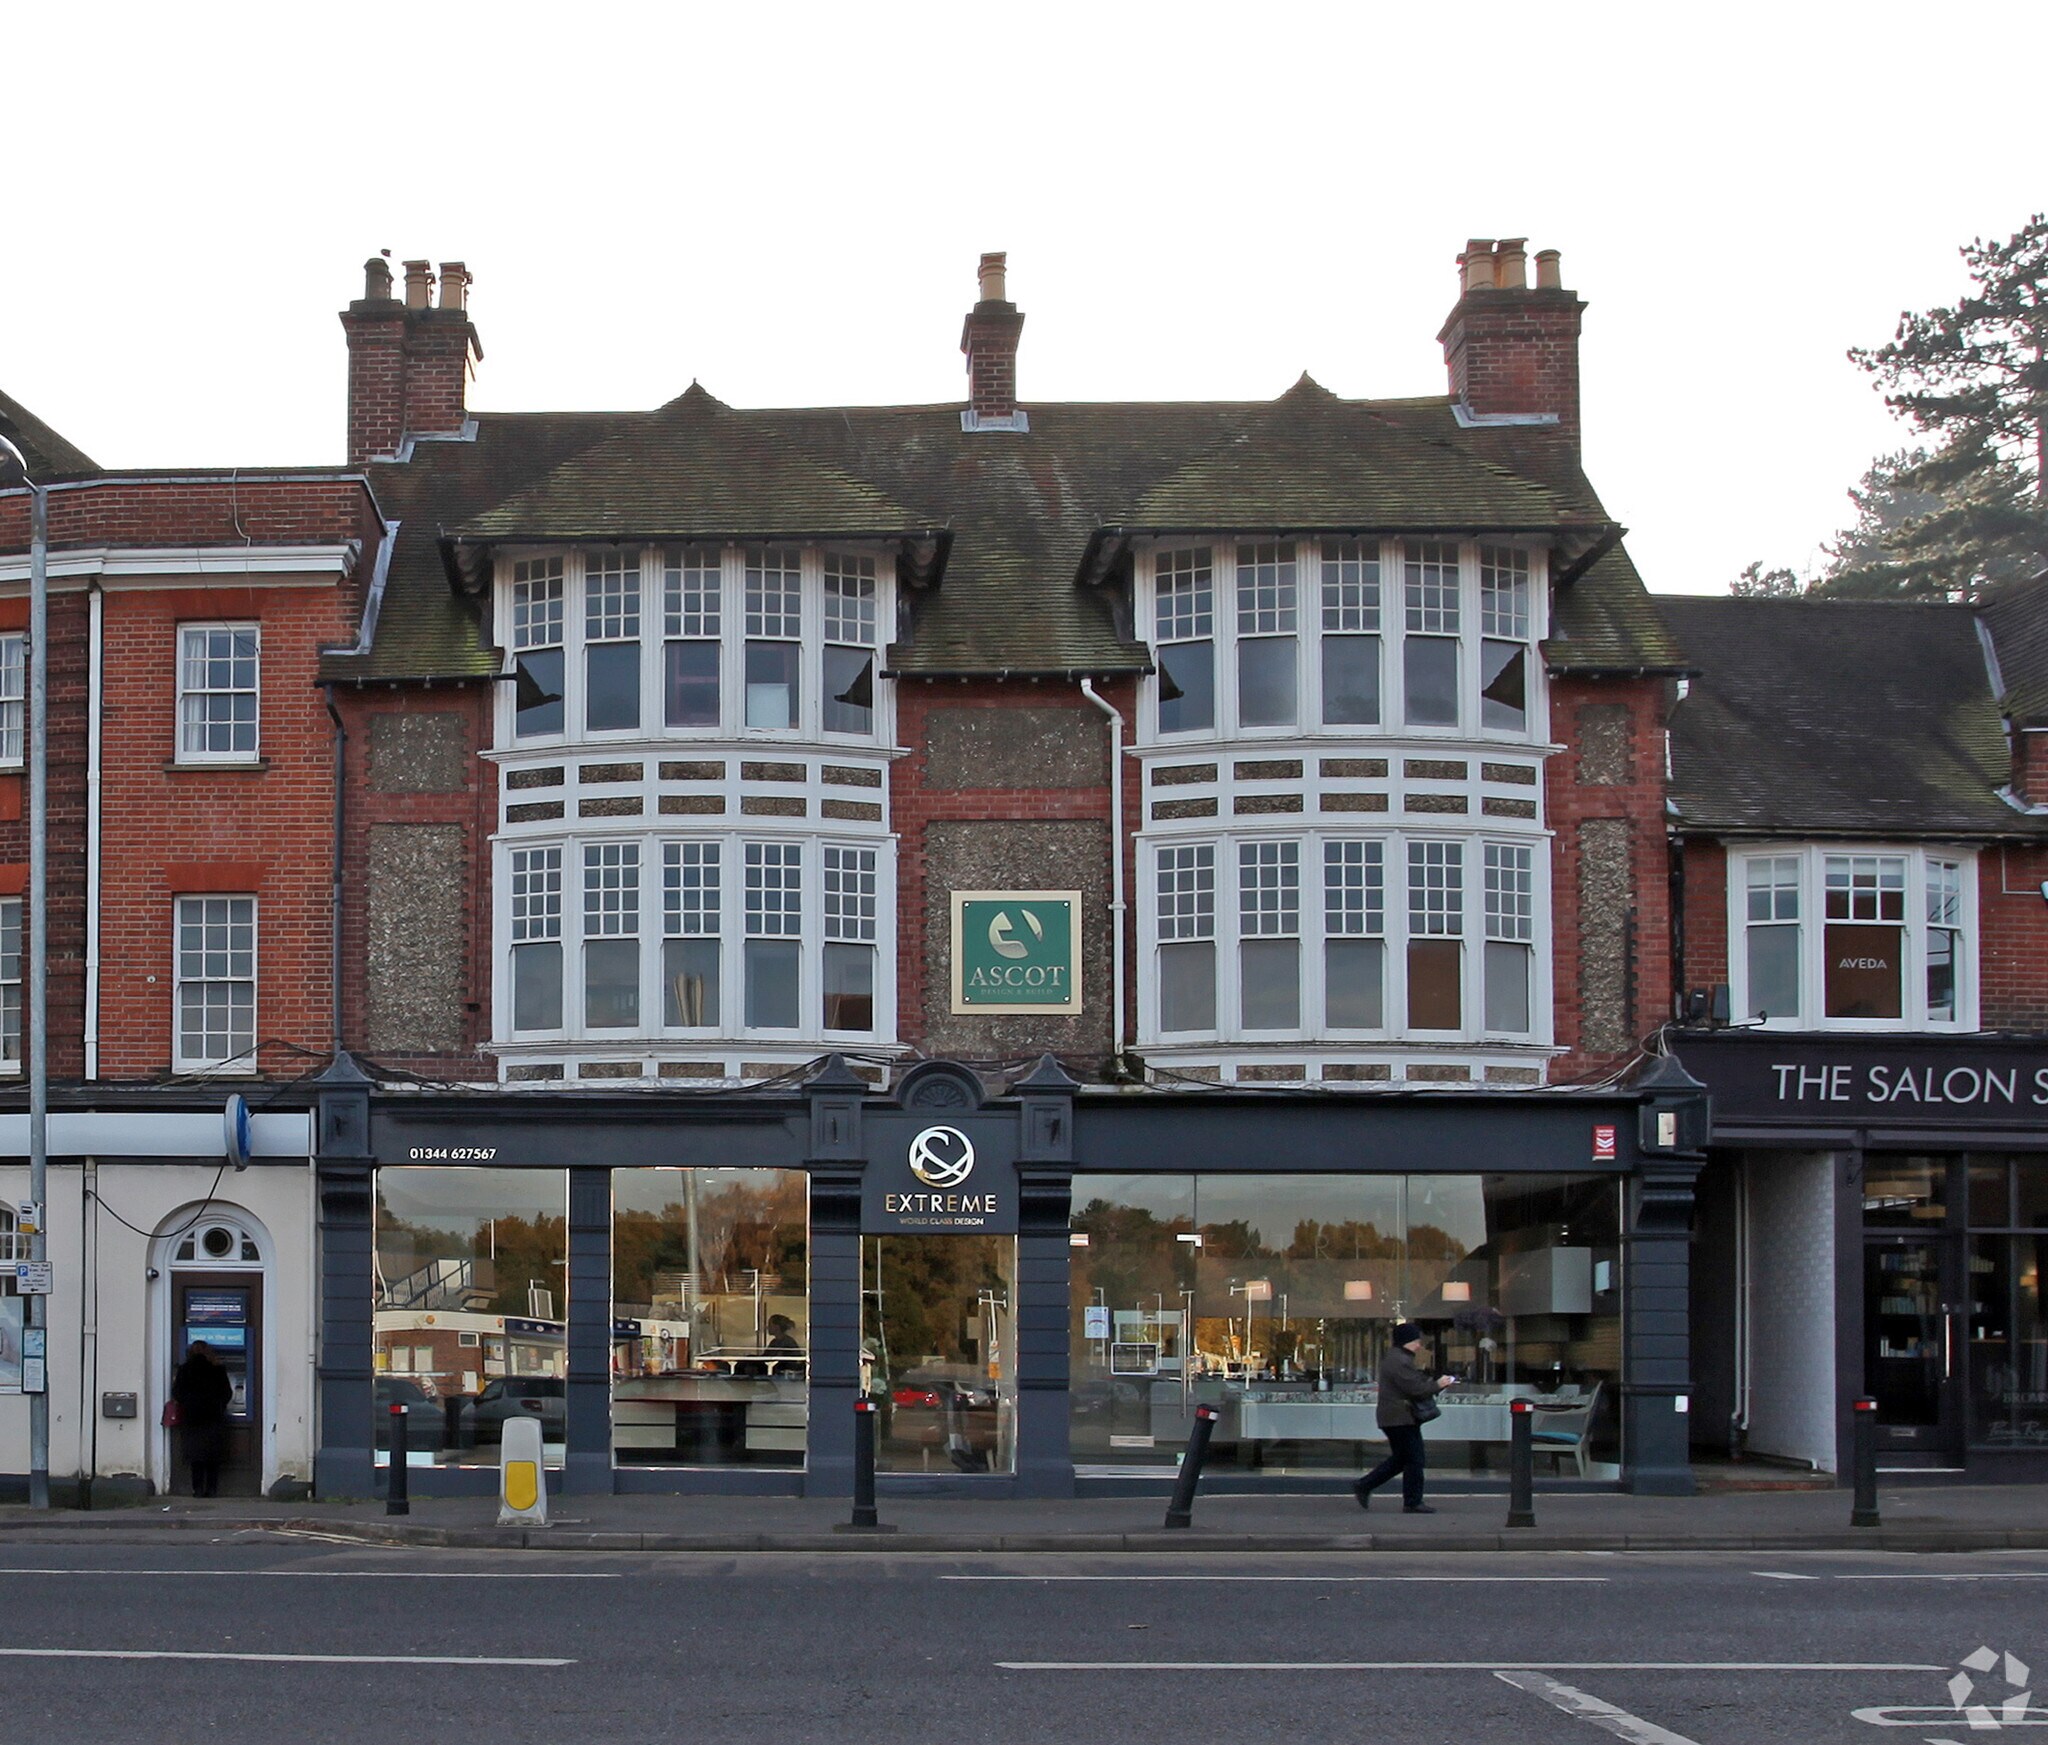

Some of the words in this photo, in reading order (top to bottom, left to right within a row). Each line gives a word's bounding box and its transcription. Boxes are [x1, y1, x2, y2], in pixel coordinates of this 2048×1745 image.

[1838, 957, 1888, 969] AVEDA
[968, 966, 1065, 986] ASCOT
[1771, 1065, 1852, 1101] THE
[1866, 1066, 2017, 1104] SALON
[409, 1147, 448, 1159] 01344
[450, 1147, 497, 1159] 627567
[885, 1194, 997, 1213] EXTREME
[899, 1217, 928, 1226] WORLD
[929, 1217, 953, 1226] CLASS
[954, 1217, 984, 1226] DESIGN
